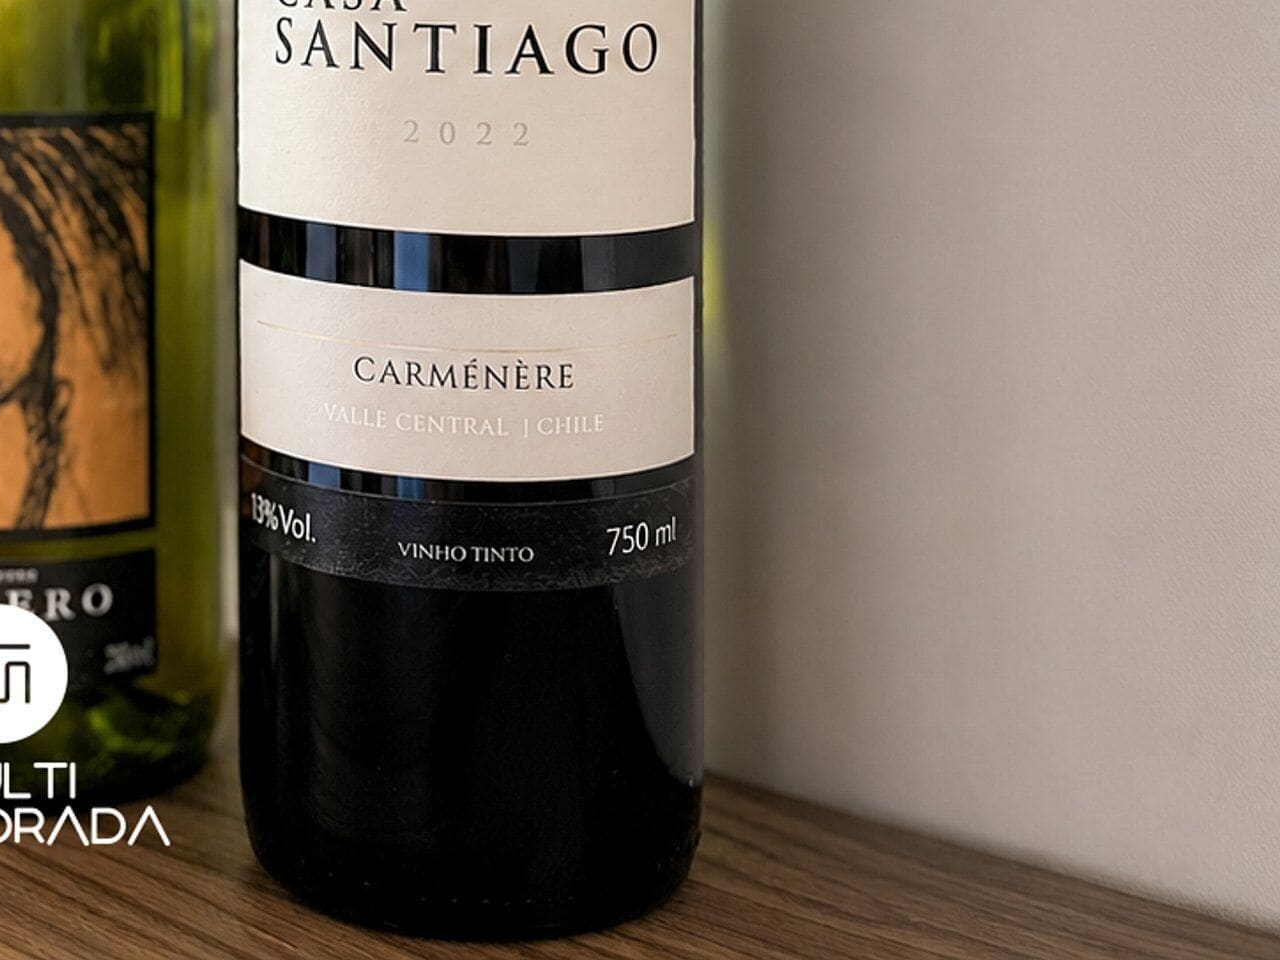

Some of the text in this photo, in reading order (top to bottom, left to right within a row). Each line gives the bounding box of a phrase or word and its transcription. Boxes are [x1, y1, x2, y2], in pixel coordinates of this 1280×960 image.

[275, 16, 658, 75] SANTIAGO
[403, 119, 531, 147] 2022
[354, 355, 575, 390] CARMÉNÈRE
[323, 401, 605, 437] VALLE CENTRAL CHILE
[397, 541, 535, 563] VINHO TINTO
[606, 515, 677, 556] 750 ml
